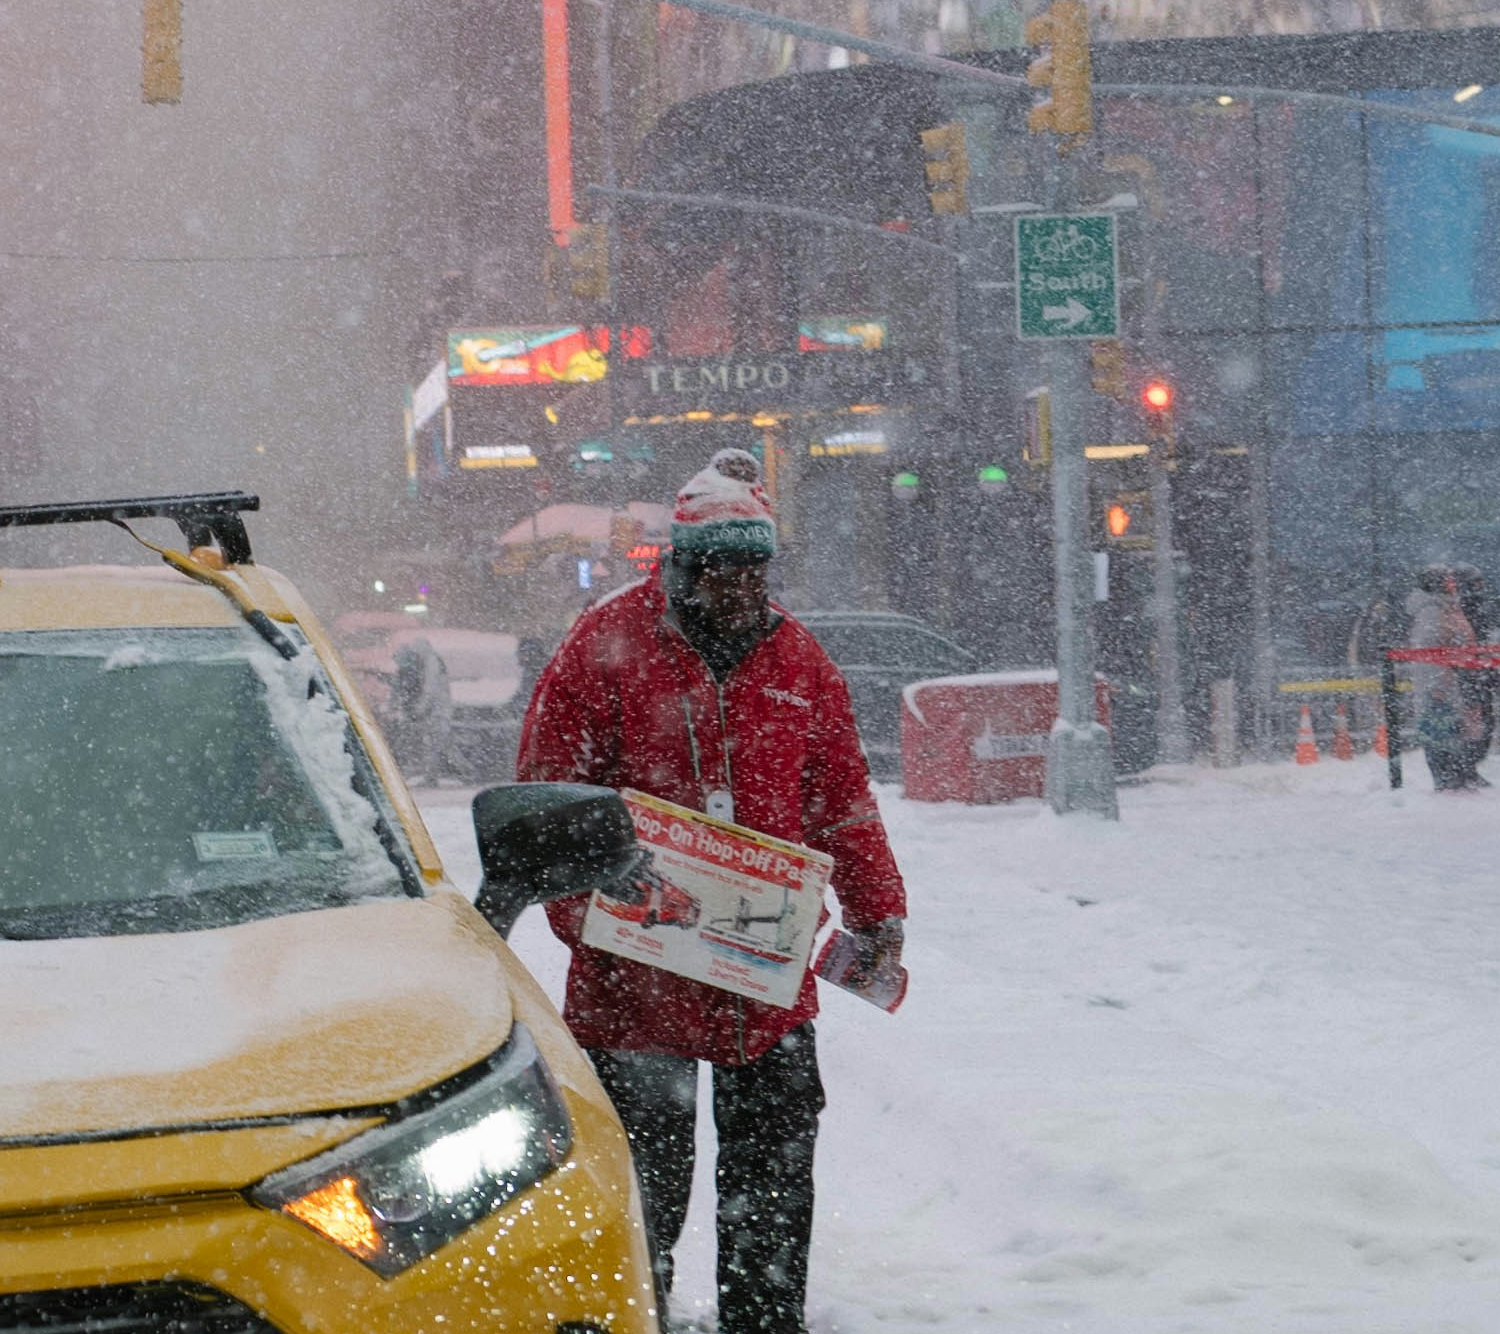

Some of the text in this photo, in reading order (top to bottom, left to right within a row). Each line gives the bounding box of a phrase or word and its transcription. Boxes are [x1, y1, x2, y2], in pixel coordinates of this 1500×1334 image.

[1027, 269, 1107, 291] South
[650, 364, 790, 392] TEMPO
[696, 834, 774, 872] Hop-Off
